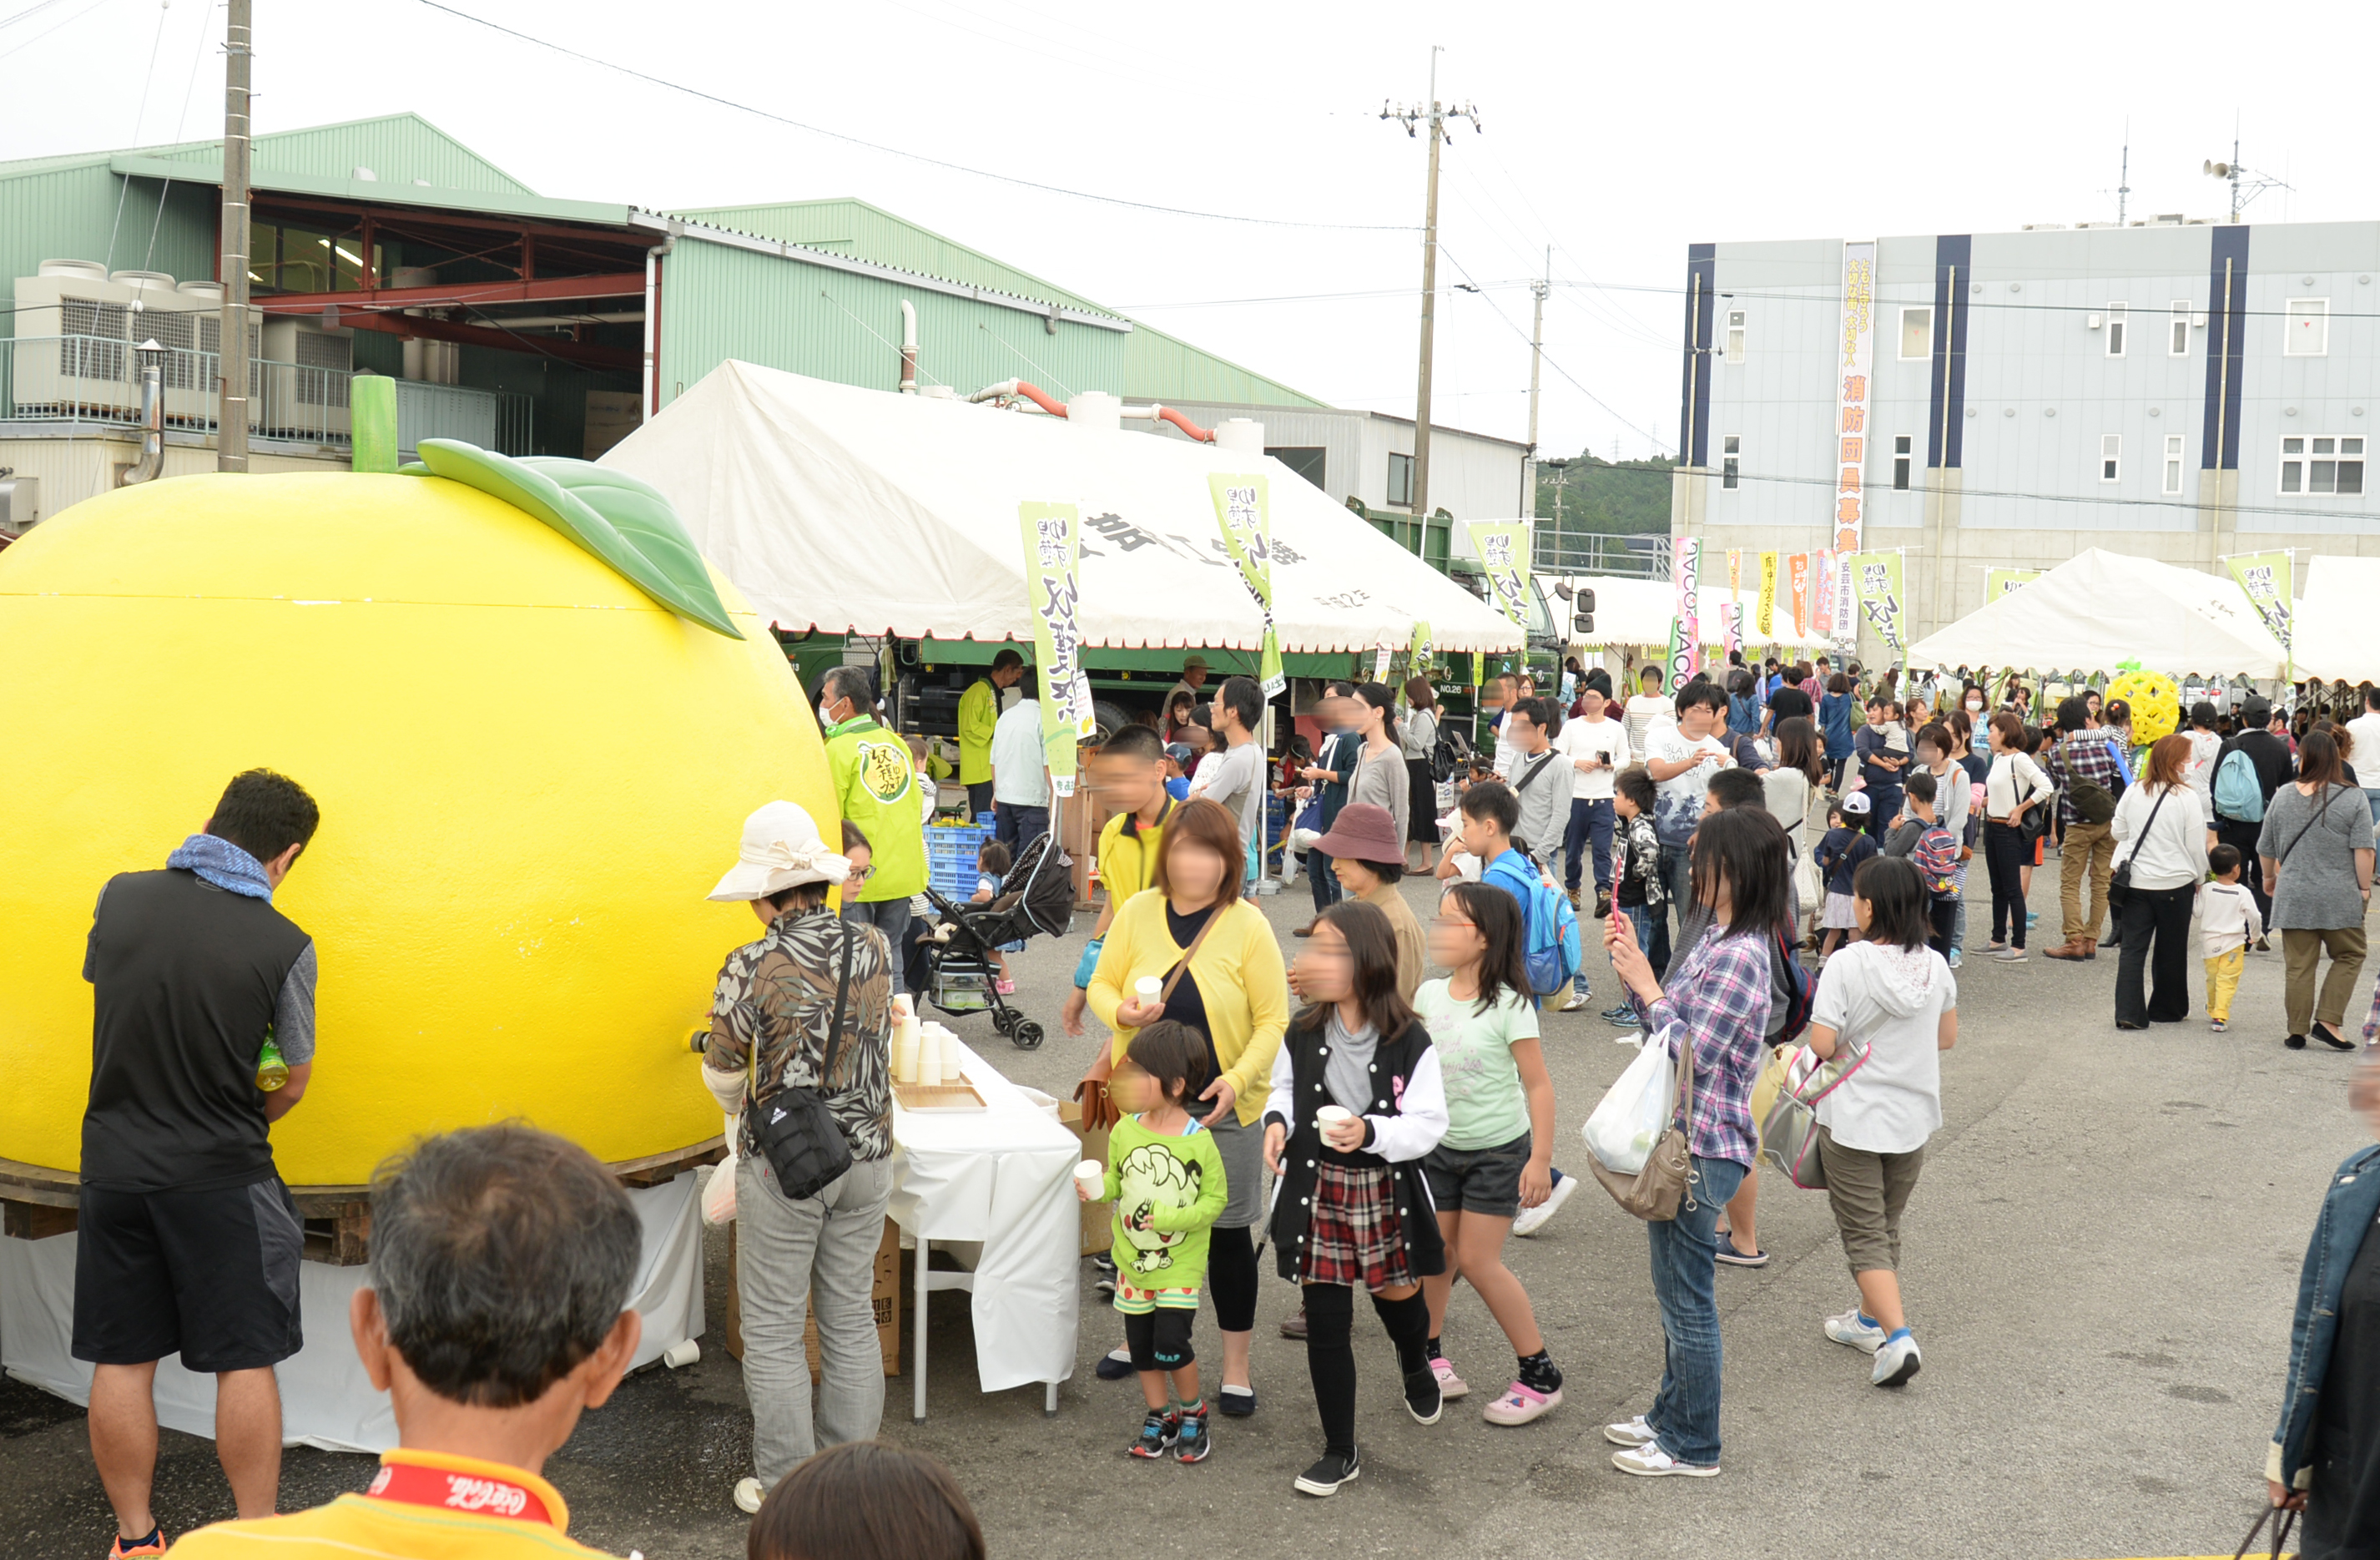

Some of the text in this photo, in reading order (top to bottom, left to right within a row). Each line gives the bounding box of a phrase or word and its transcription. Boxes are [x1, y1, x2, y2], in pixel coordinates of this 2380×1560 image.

[1844, 260, 1859, 367] 大切な街、大切な人
[1859, 259, 1870, 332] ともに守ろう
[1836, 375, 1867, 554] 消防団員募集
[1838, 562, 1850, 630] 安芸市消防団
[1440, 684, 1461, 694] NO.26
